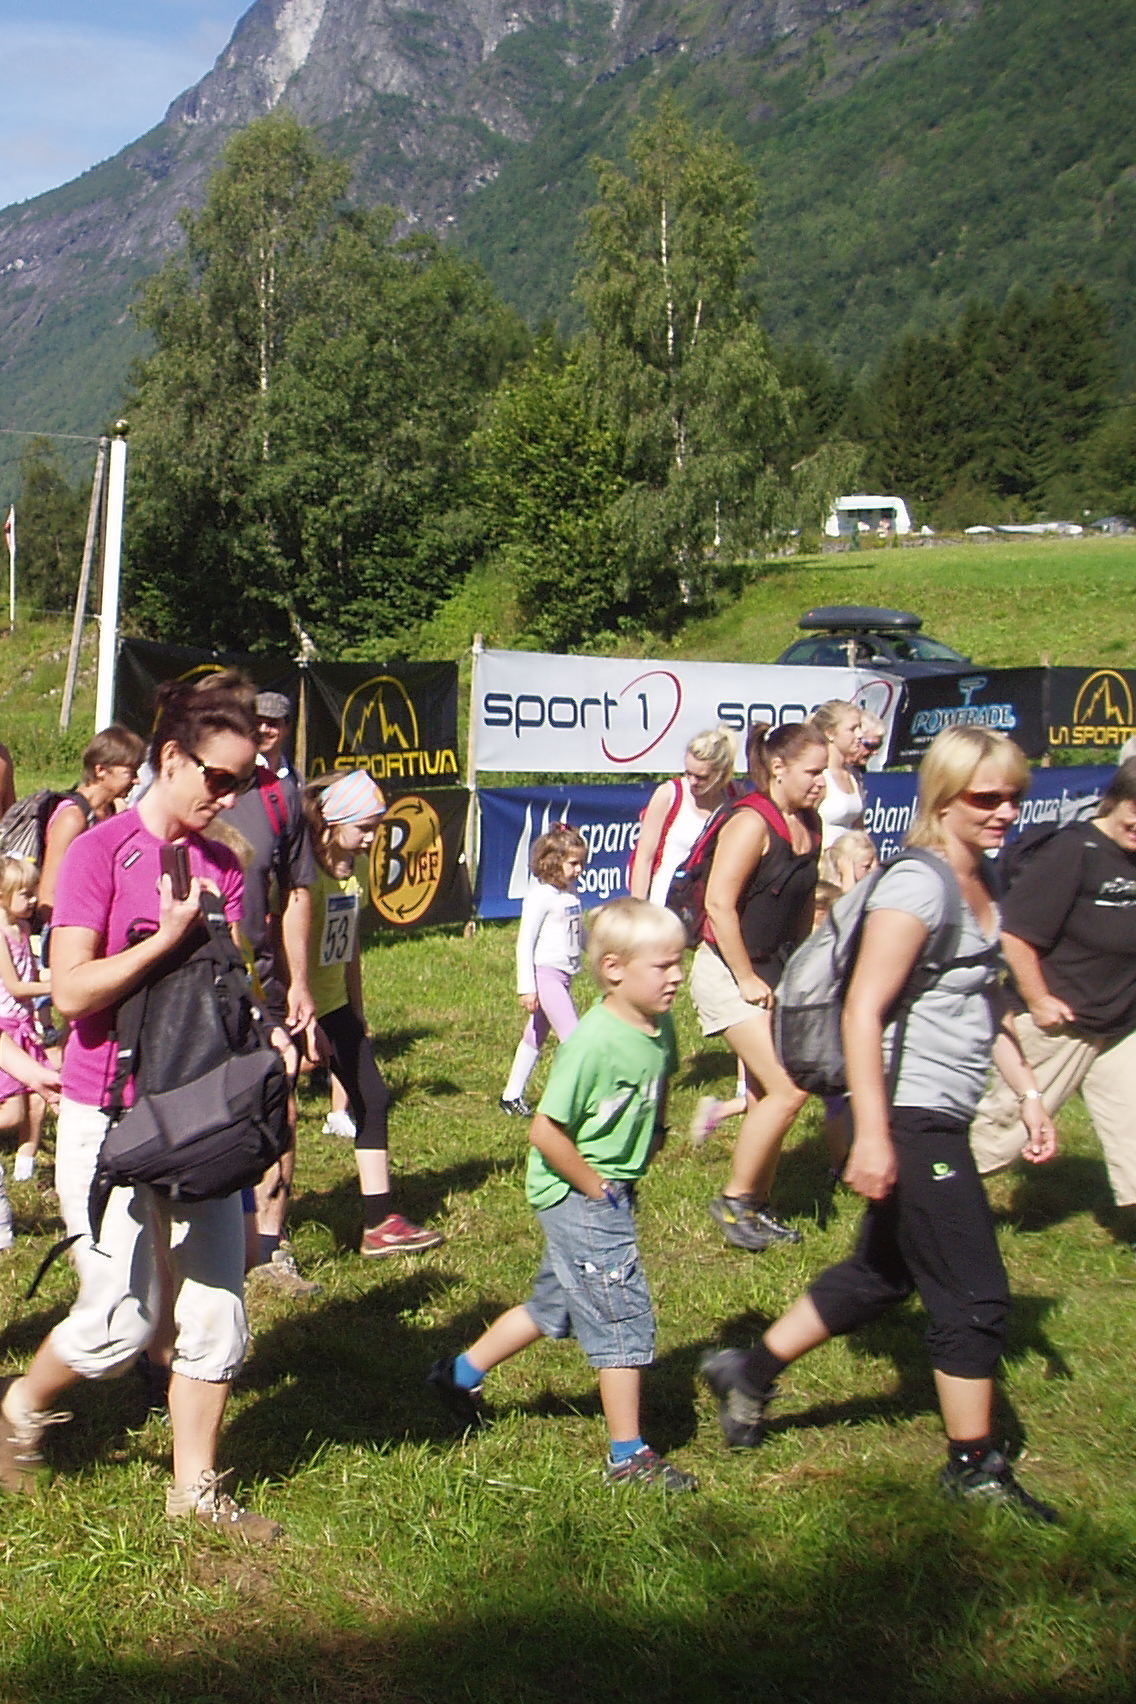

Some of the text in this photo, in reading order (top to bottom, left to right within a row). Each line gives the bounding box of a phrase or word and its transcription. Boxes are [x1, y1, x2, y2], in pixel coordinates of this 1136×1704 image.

[483, 691, 648, 738] sport 1
[718, 702, 822, 731] spo
[1049, 725, 1136, 745] LA SPORT
[576, 865, 620, 899] sogn
[324, 915, 348, 962] 53
